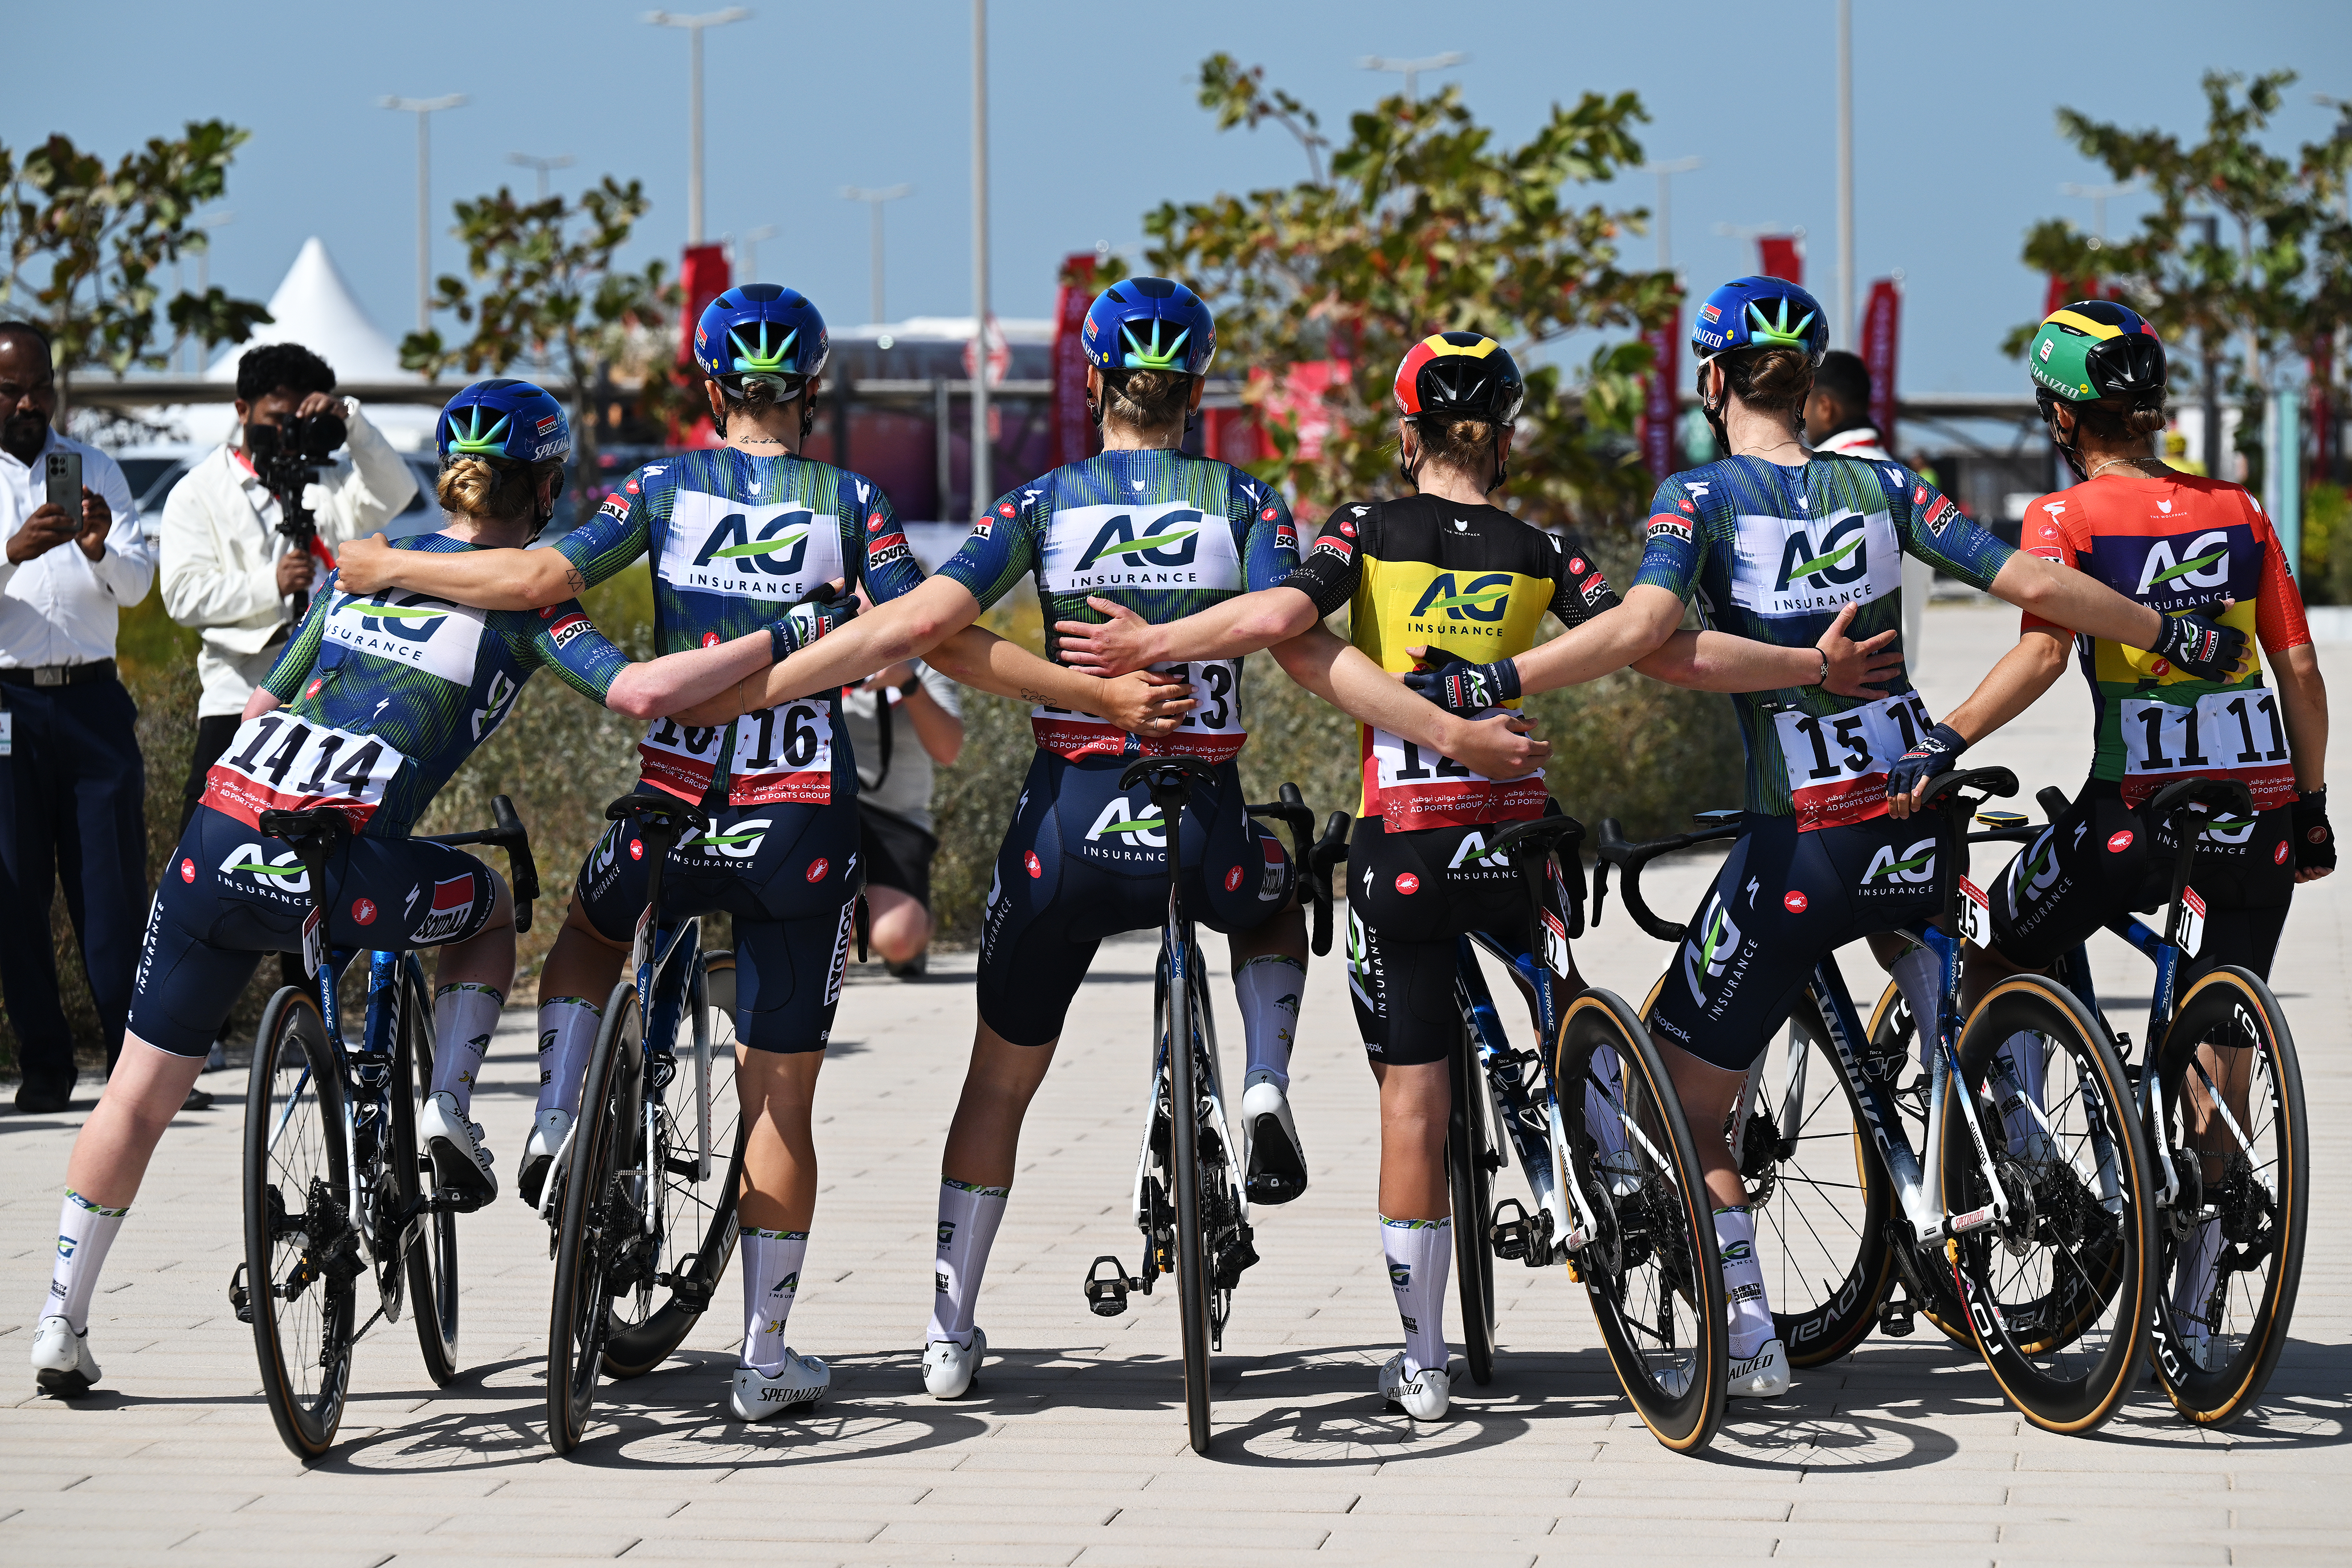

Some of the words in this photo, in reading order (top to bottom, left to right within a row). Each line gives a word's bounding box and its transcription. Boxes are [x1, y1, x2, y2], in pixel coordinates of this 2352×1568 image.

[1693, 325, 1723, 348] ALIZED
[531, 434, 570, 461] SPECIAL
[538, 422, 557, 435] SOUDAL
[602, 502, 624, 522] DAL
[692, 508, 814, 576] AG
[1073, 510, 1204, 567] AG
[1774, 512, 1868, 592] AG
[1071, 572, 1197, 587] INSURANCE
[2135, 531, 2228, 595] AG
[689, 573, 803, 594] INSURANCE
[1410, 573, 1514, 622] AG
[1774, 583, 1873, 611] INSURANCE
[2142, 590, 2232, 609] NSURANCE
[325, 623, 423, 662] NSURANCE
[556, 621, 597, 647] SOUD
[1408, 622, 1504, 638] INSURANCE
[2180, 619, 2199, 663] AG
[2188, 625, 2203, 665] INSURANCE
[2205, 631, 2218, 662] SOUDAL
[471, 669, 516, 742] AG
[1446, 676, 1457, 708] SOUDAL
[1461, 667, 1472, 708] INSURANCE
[1467, 667, 1492, 707] AG
[746, 705, 818, 770] 16
[1087, 742, 1118, 751] GROUP
[1795, 714, 1873, 779] 15
[2137, 704, 2210, 770] 11
[2226, 695, 2288, 762] 11
[229, 716, 312, 786] 14
[296, 734, 384, 798] 14
[230, 793, 254, 809] PORTS
[684, 777, 709, 790] GROUP
[1827, 803, 1838, 812] AD
[1839, 799, 1864, 809] PORTS
[1864, 793, 1886, 805] GROU
[1455, 801, 1483, 810] GROUP
[672, 818, 773, 858] AG
[1084, 845, 1168, 862] INSURANC
[2157, 832, 2245, 855] INSRANCE
[668, 851, 754, 869] INSURANCE
[1447, 871, 1518, 881] INSURANC
[1860, 837, 1936, 885] AG
[2007, 824, 2061, 921] AG
[218, 873, 312, 906] INSURANCE
[591, 863, 620, 903] INSURANCE
[1859, 884, 1934, 897] INSURANCE
[415, 907, 469, 938] SOUDAL
[1959, 895, 1978, 940] 15
[2016, 877, 2073, 938] INSURANCE
[985, 896, 1012, 965] INSURANCE
[2177, 905, 2194, 950] 11
[137, 901, 165, 995] INSURANCE
[827, 899, 854, 1006] SOUDAL
[1684, 890, 1741, 1008] AG
[1368, 925, 1388, 1019] INSURANCE
[1707, 938, 1759, 1021] INSURANCE
[1949, 950, 1958, 1001] TARMAC
[2163, 958, 2175, 1010] TARMAC
[320, 976, 333, 1030] TARMAC
[1542, 979, 1556, 1032] TARMAC
[1366, 1042, 1383, 1054] opak
[448, 1107, 491, 1173] SPECIALIZED
[1969, 1120, 1987, 1167] SHIMANO
[946, 1179, 963, 1189] AG
[1955, 1210, 1984, 1230] SPECIALIZED
[1723, 1259, 1754, 1270] RANCE
[1732, 1283, 1761, 1295] SAFETY
[1734, 1289, 1762, 1300] JOGGER
[1736, 1296, 1762, 1305] WORKWEAR
[1728, 1353, 1774, 1382] ALIZED
[757, 1385, 827, 1402] SPECIALIZED
[1386, 1383, 1424, 1399] SPECIALIZED
